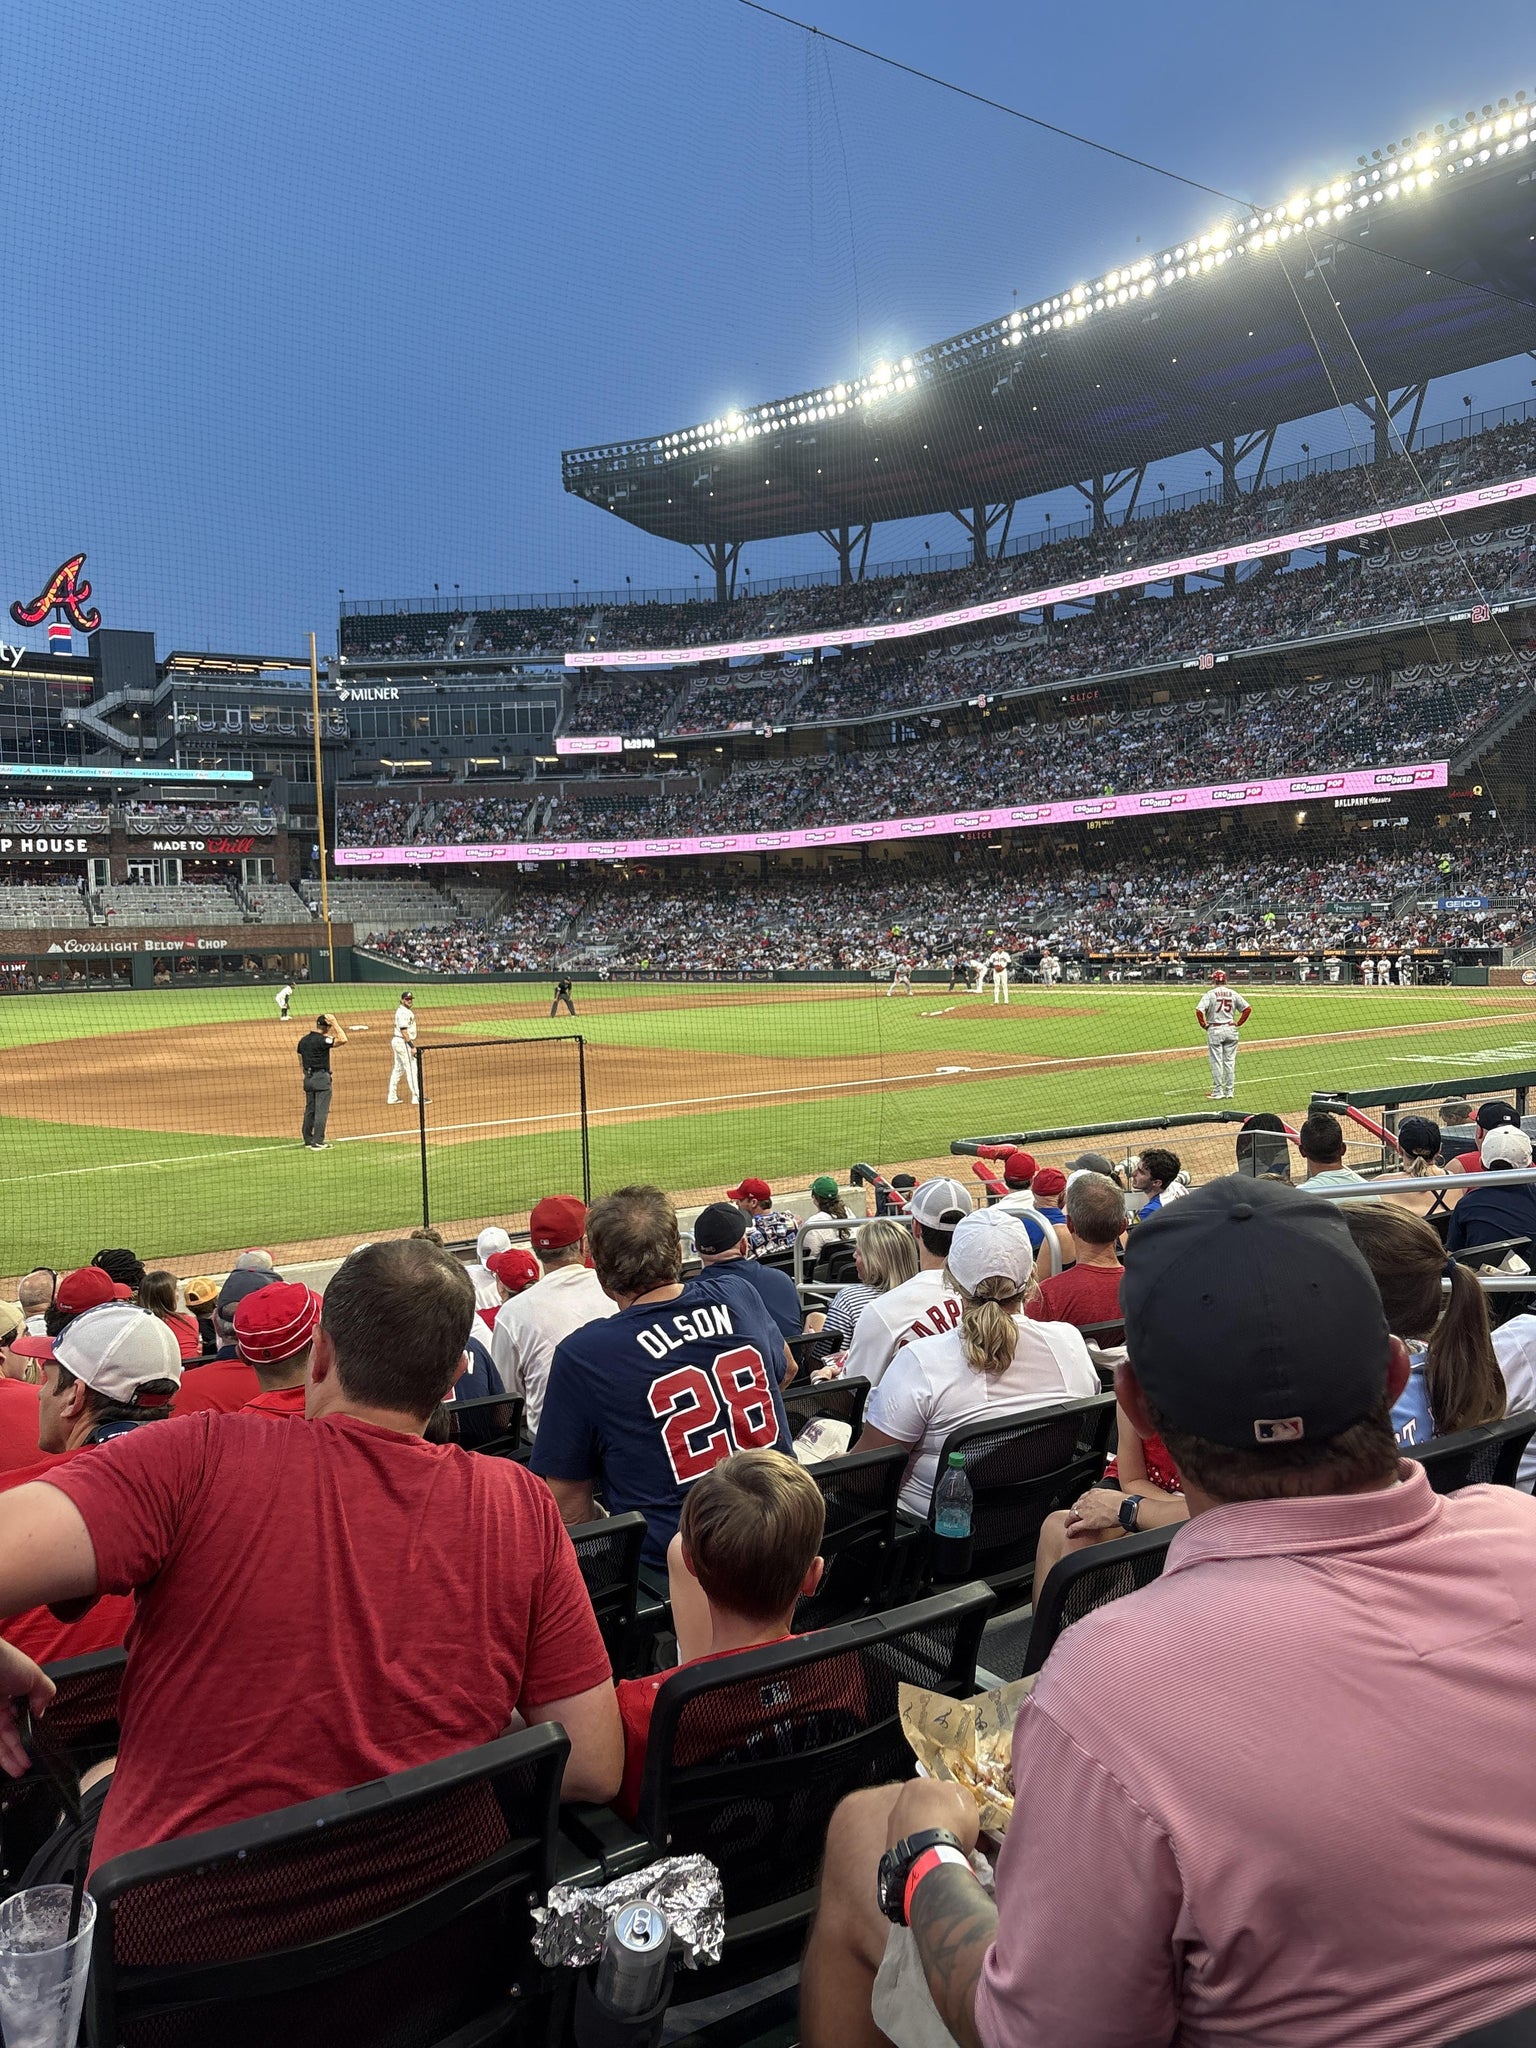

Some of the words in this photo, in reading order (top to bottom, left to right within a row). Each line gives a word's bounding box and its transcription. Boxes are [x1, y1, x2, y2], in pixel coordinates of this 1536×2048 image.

[1472, 604, 1490, 623] 21
[1199, 653, 1214, 670] 10
[351, 687, 400, 701] MILNER
[1070, 690, 1099, 703] SLICE
[764, 725, 773, 738] 3
[1375, 775, 1414, 784] CROOKED
[1415, 771, 1433, 779] POP
[1291, 783, 1326, 792] CROOKED
[1327, 780, 1343, 788] POP
[1472, 785, 1483, 797] Q
[1141, 799, 1171, 807] CROOKED
[1172, 795, 1186, 803] POP
[1213, 792, 1245, 800] CROOKED
[1334, 797, 1369, 808] BALLPARK
[967, 832, 992, 840] SLICE
[0, 838, 13, 852] P
[21, 838, 88, 853] HOUSE
[153, 841, 187, 850] MADE
[189, 841, 205, 850] TO
[207, 837, 255, 854] Chill
[1445, 900, 1481, 908] GEICO
[64, 939, 102, 953] Coors
[104, 942, 139, 952] LIGHT
[145, 940, 184, 951] BELOW
[197, 939, 228, 950] CHOP
[1215, 998, 1233, 1014] 75
[636, 1304, 734, 1359] OLSON
[647, 1345, 780, 1485] 28
